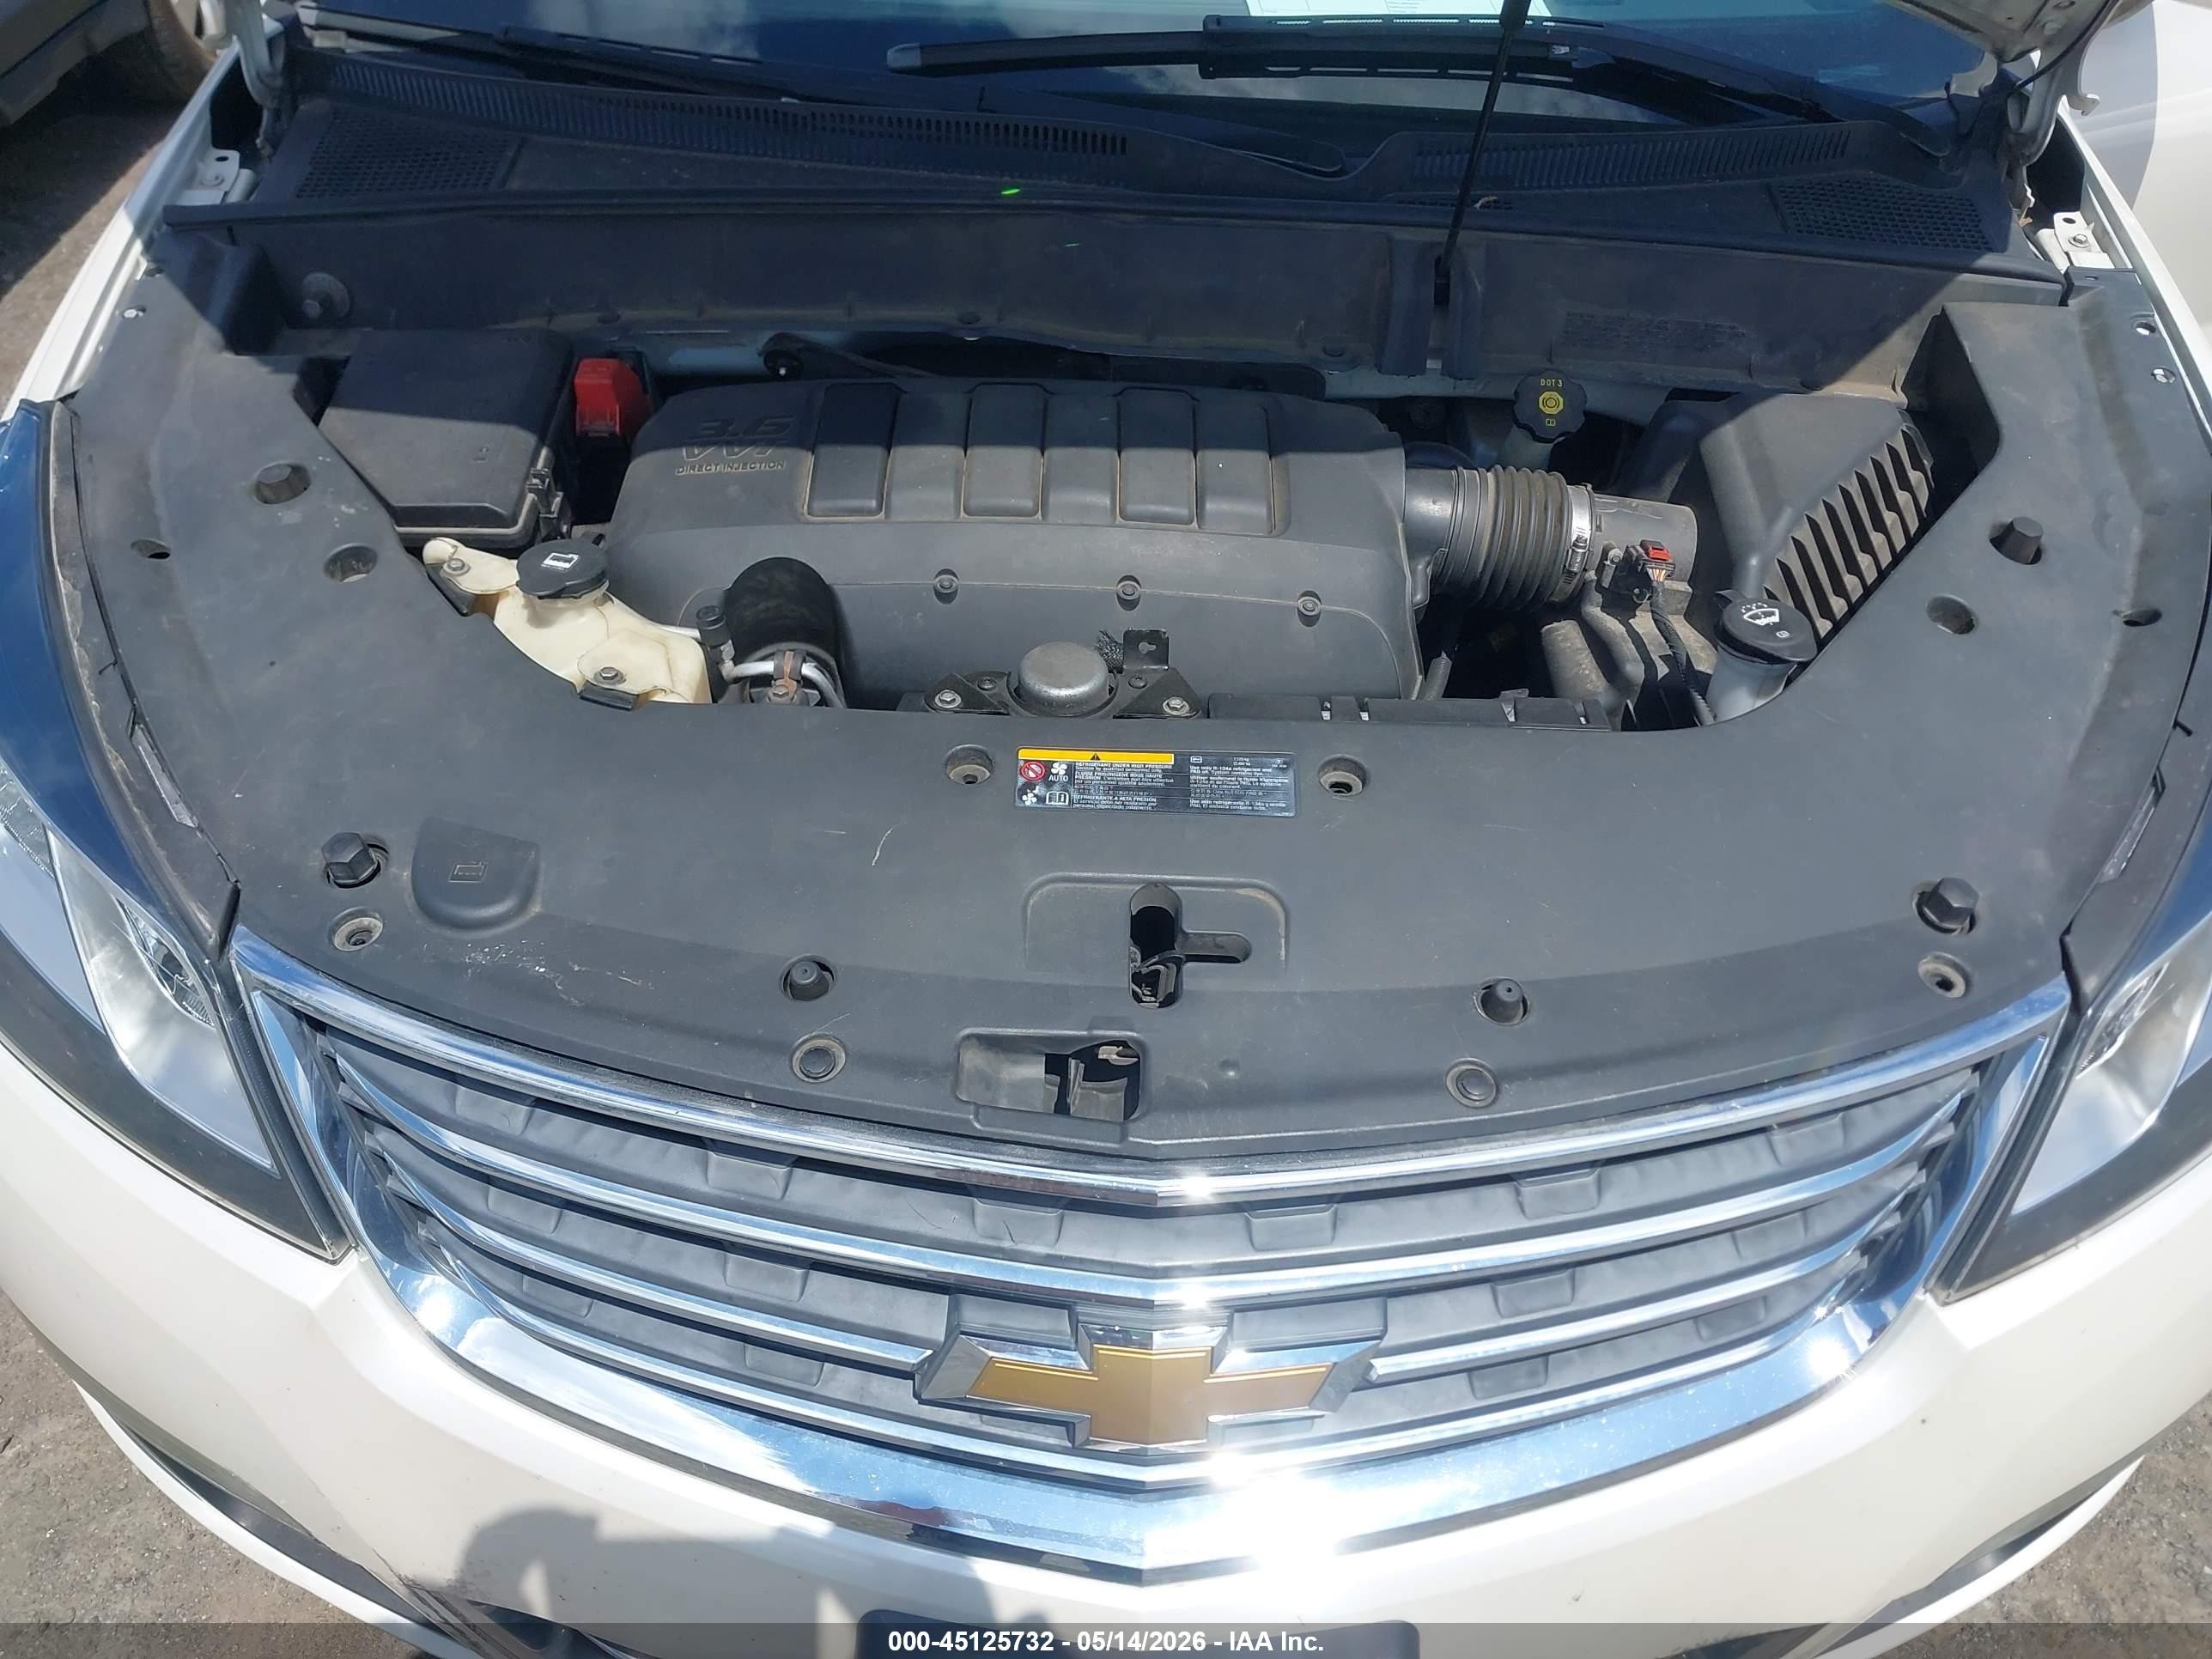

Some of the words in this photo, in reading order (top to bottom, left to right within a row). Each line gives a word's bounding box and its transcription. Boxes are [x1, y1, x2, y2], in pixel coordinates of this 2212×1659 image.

[1540, 378, 1555, 386] DOT
[1559, 379, 1563, 387] 3
[676, 465, 720, 476] DIRECT
[722, 460, 786, 473] INJECTION
